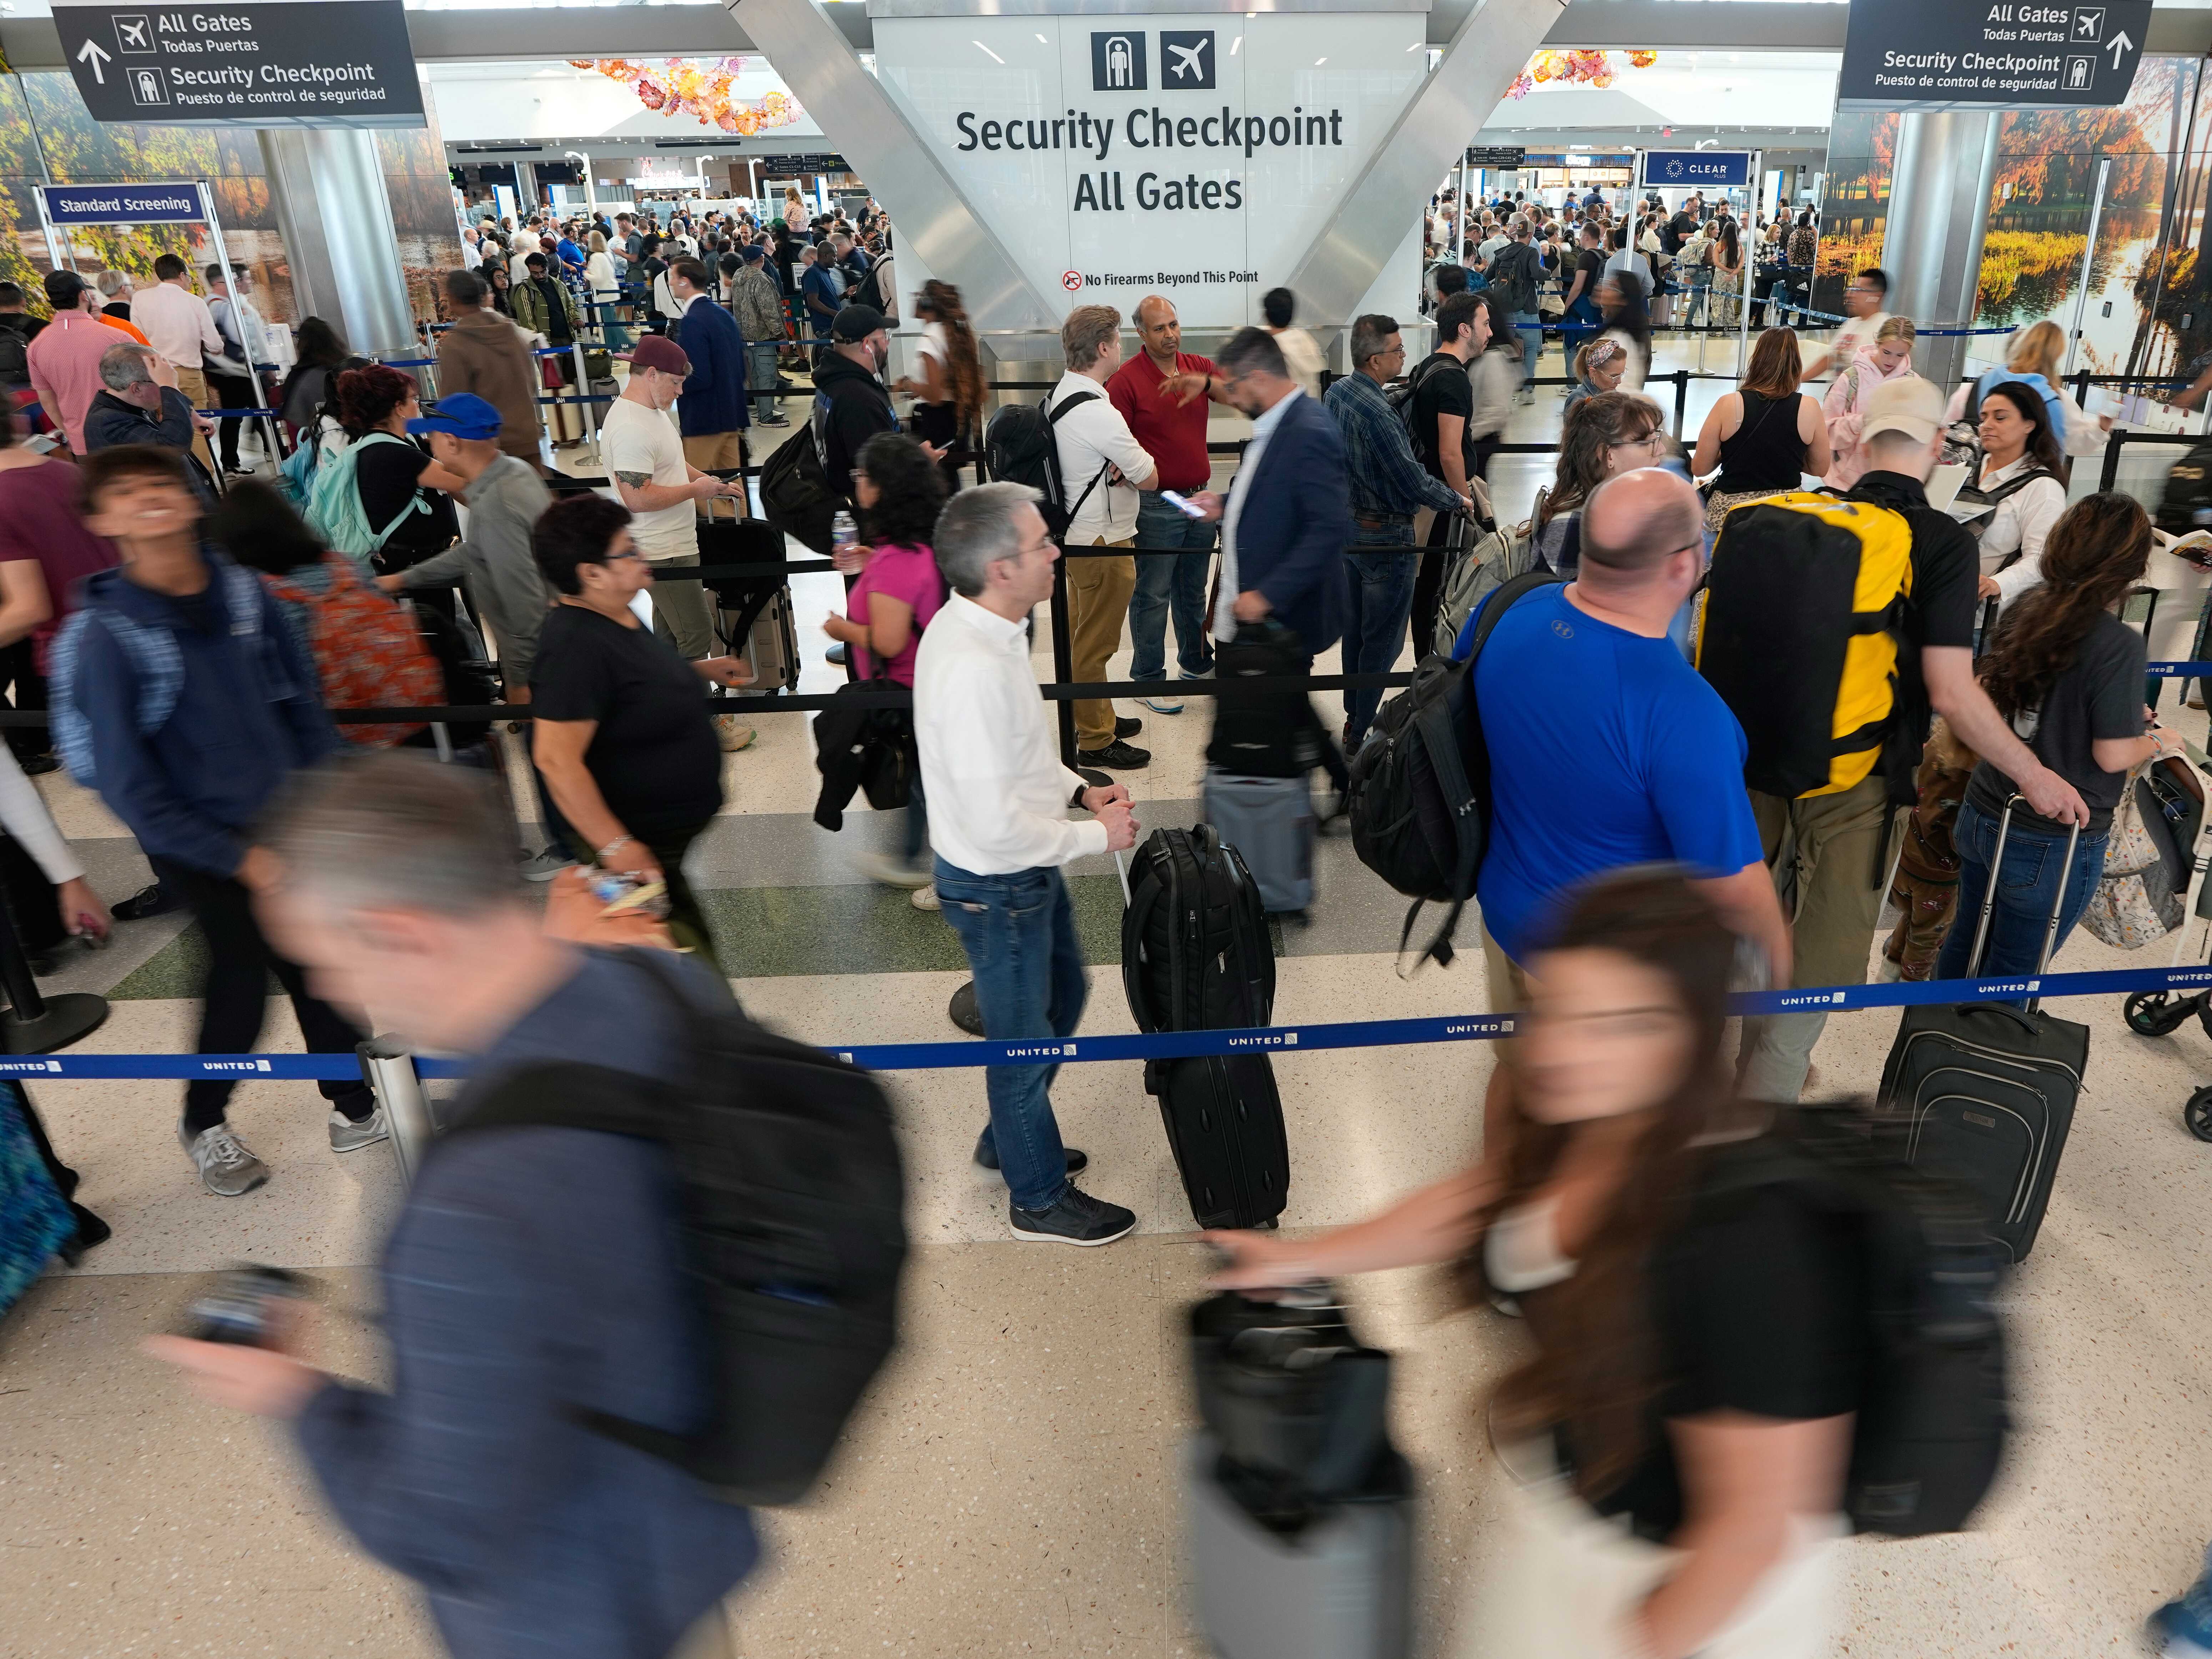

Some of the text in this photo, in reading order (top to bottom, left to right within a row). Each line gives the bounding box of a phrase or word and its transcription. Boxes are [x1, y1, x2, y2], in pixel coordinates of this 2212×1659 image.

[1987, 5, 2068, 23] All Gates
[159, 14, 252, 32] All Gates
[1984, 29, 2065, 42] Todas Puertas
[161, 40, 259, 52] Todas Puertas
[1884, 51, 2060, 75] Security Checkpoint
[171, 64, 375, 87] Security Checkpoint
[1876, 74, 2057, 92] Puesto de control de seguridad
[176, 87, 386, 105] Puesto de control de seguridad
[957, 107, 1342, 160] Security Checkpoint
[1074, 172, 1242, 211] All Gates
[60, 197, 191, 212] Standard Screening
[1085, 271, 1258, 287] No Firearms Beyond This Point
[1979, 984, 2025, 993] UNITED
[1782, 996, 1830, 1005] UNITED
[1447, 1024, 1498, 1033] UNITED
[1229, 1037, 1281, 1045] UNITED
[1007, 1048, 1060, 1057] UNITED
